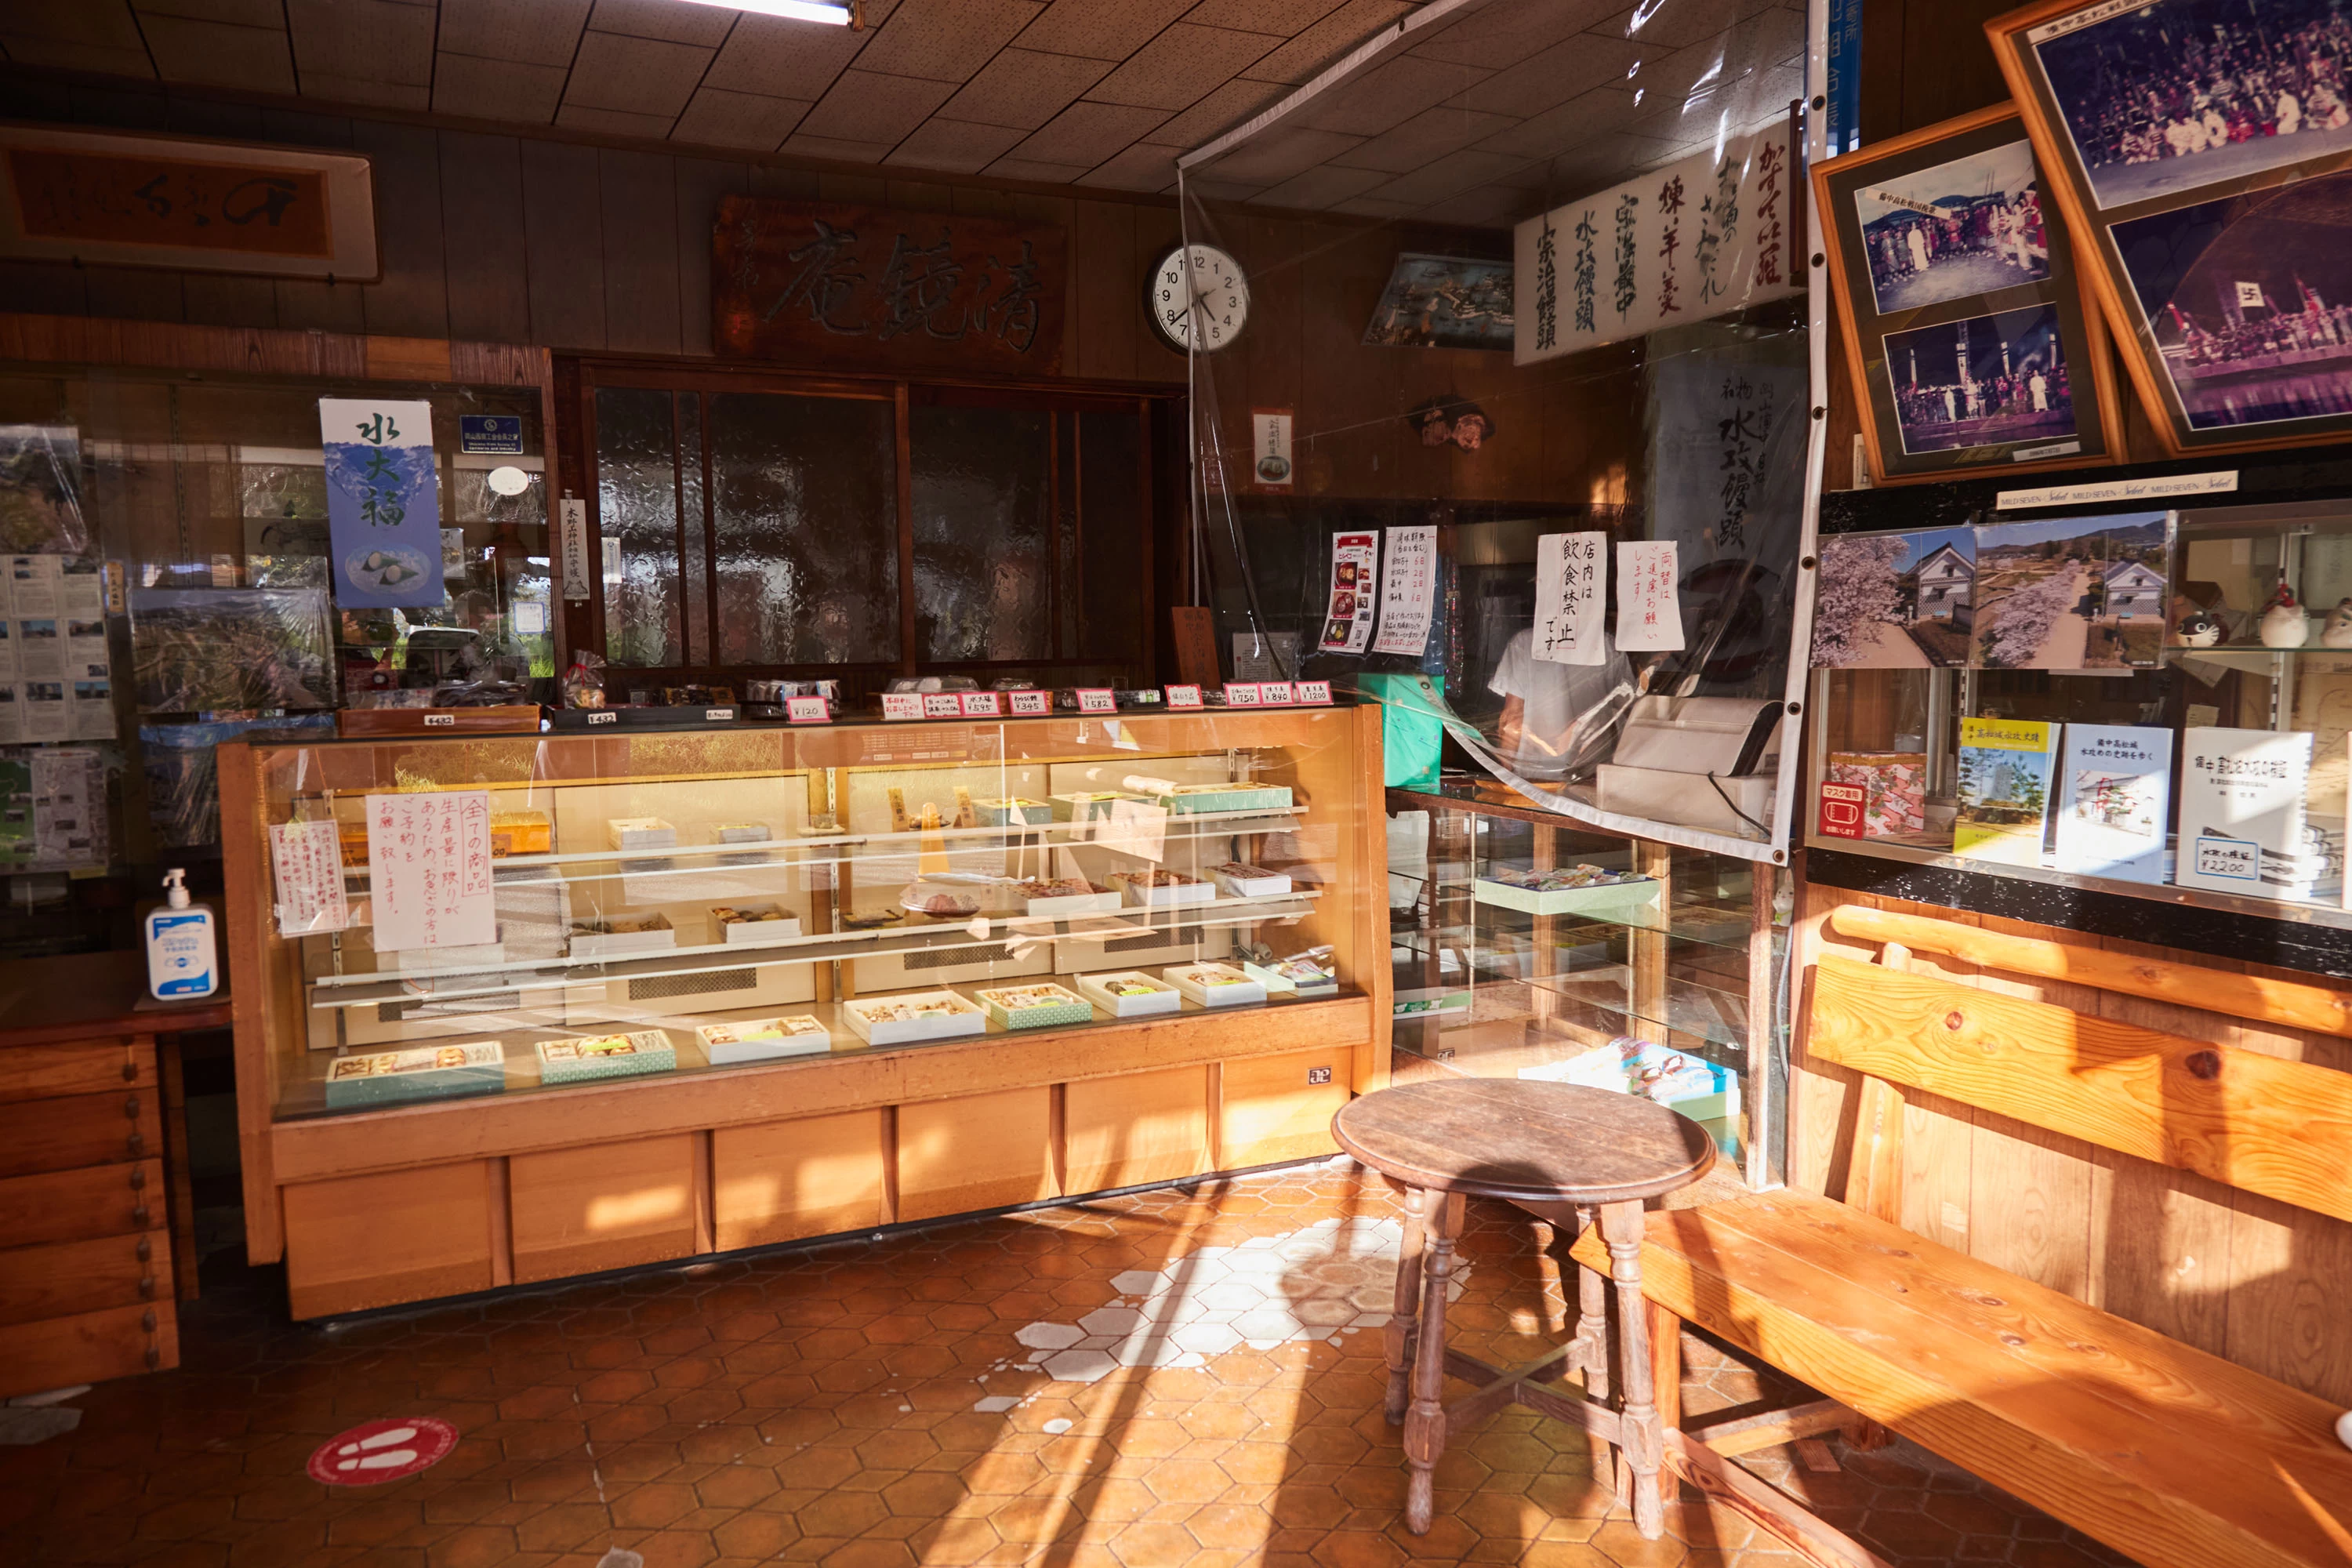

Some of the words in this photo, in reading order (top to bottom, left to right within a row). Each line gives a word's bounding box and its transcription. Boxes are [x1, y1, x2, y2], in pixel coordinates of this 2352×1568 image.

[1194, 257, 1205, 268] 12
[1213, 263, 1218, 274] 1
[1166, 272, 1178, 283] 10
[1225, 277, 1232, 289] 2
[1162, 290, 1170, 301] 9
[1229, 296, 1236, 308] 3
[1167, 310, 1174, 321] 8
[1223, 315, 1231, 326] 4
[1180, 325, 1187, 336] 7
[1212, 327, 1220, 338] 5
[355, 412, 405, 528] 水大福
[2151, 485, 2171, 494] MILD
[2171, 483, 2199, 492] SEVEN
[2019, 495, 2042, 504] SEVEN
[2073, 492, 2092, 501] MILD
[2092, 490, 2117, 499] SEVEN
[1582, 540, 1595, 599] 店内は
[1632, 550, 1643, 603] します
[1660, 551, 1673, 600] 両替は
[1557, 538, 1579, 643] 飲食禁止
[1085, 700, 1109, 708] ¥582
[1232, 694, 1254, 703] ¥750
[793, 707, 819, 717] ¥120
[967, 703, 992, 712] ¥595
[2096, 739, 2139, 750] 備中高松城
[2081, 748, 2153, 760] 水攻めの史跡を歩く
[1826, 788, 1859, 800] マスク着用
[399, 797, 416, 863] ご予約を
[1825, 826, 1856, 837] お願いします
[464, 800, 488, 892] 全ての商品
[379, 800, 399, 916] お願い致します。
[439, 799, 459, 916] 生産量に限りが
